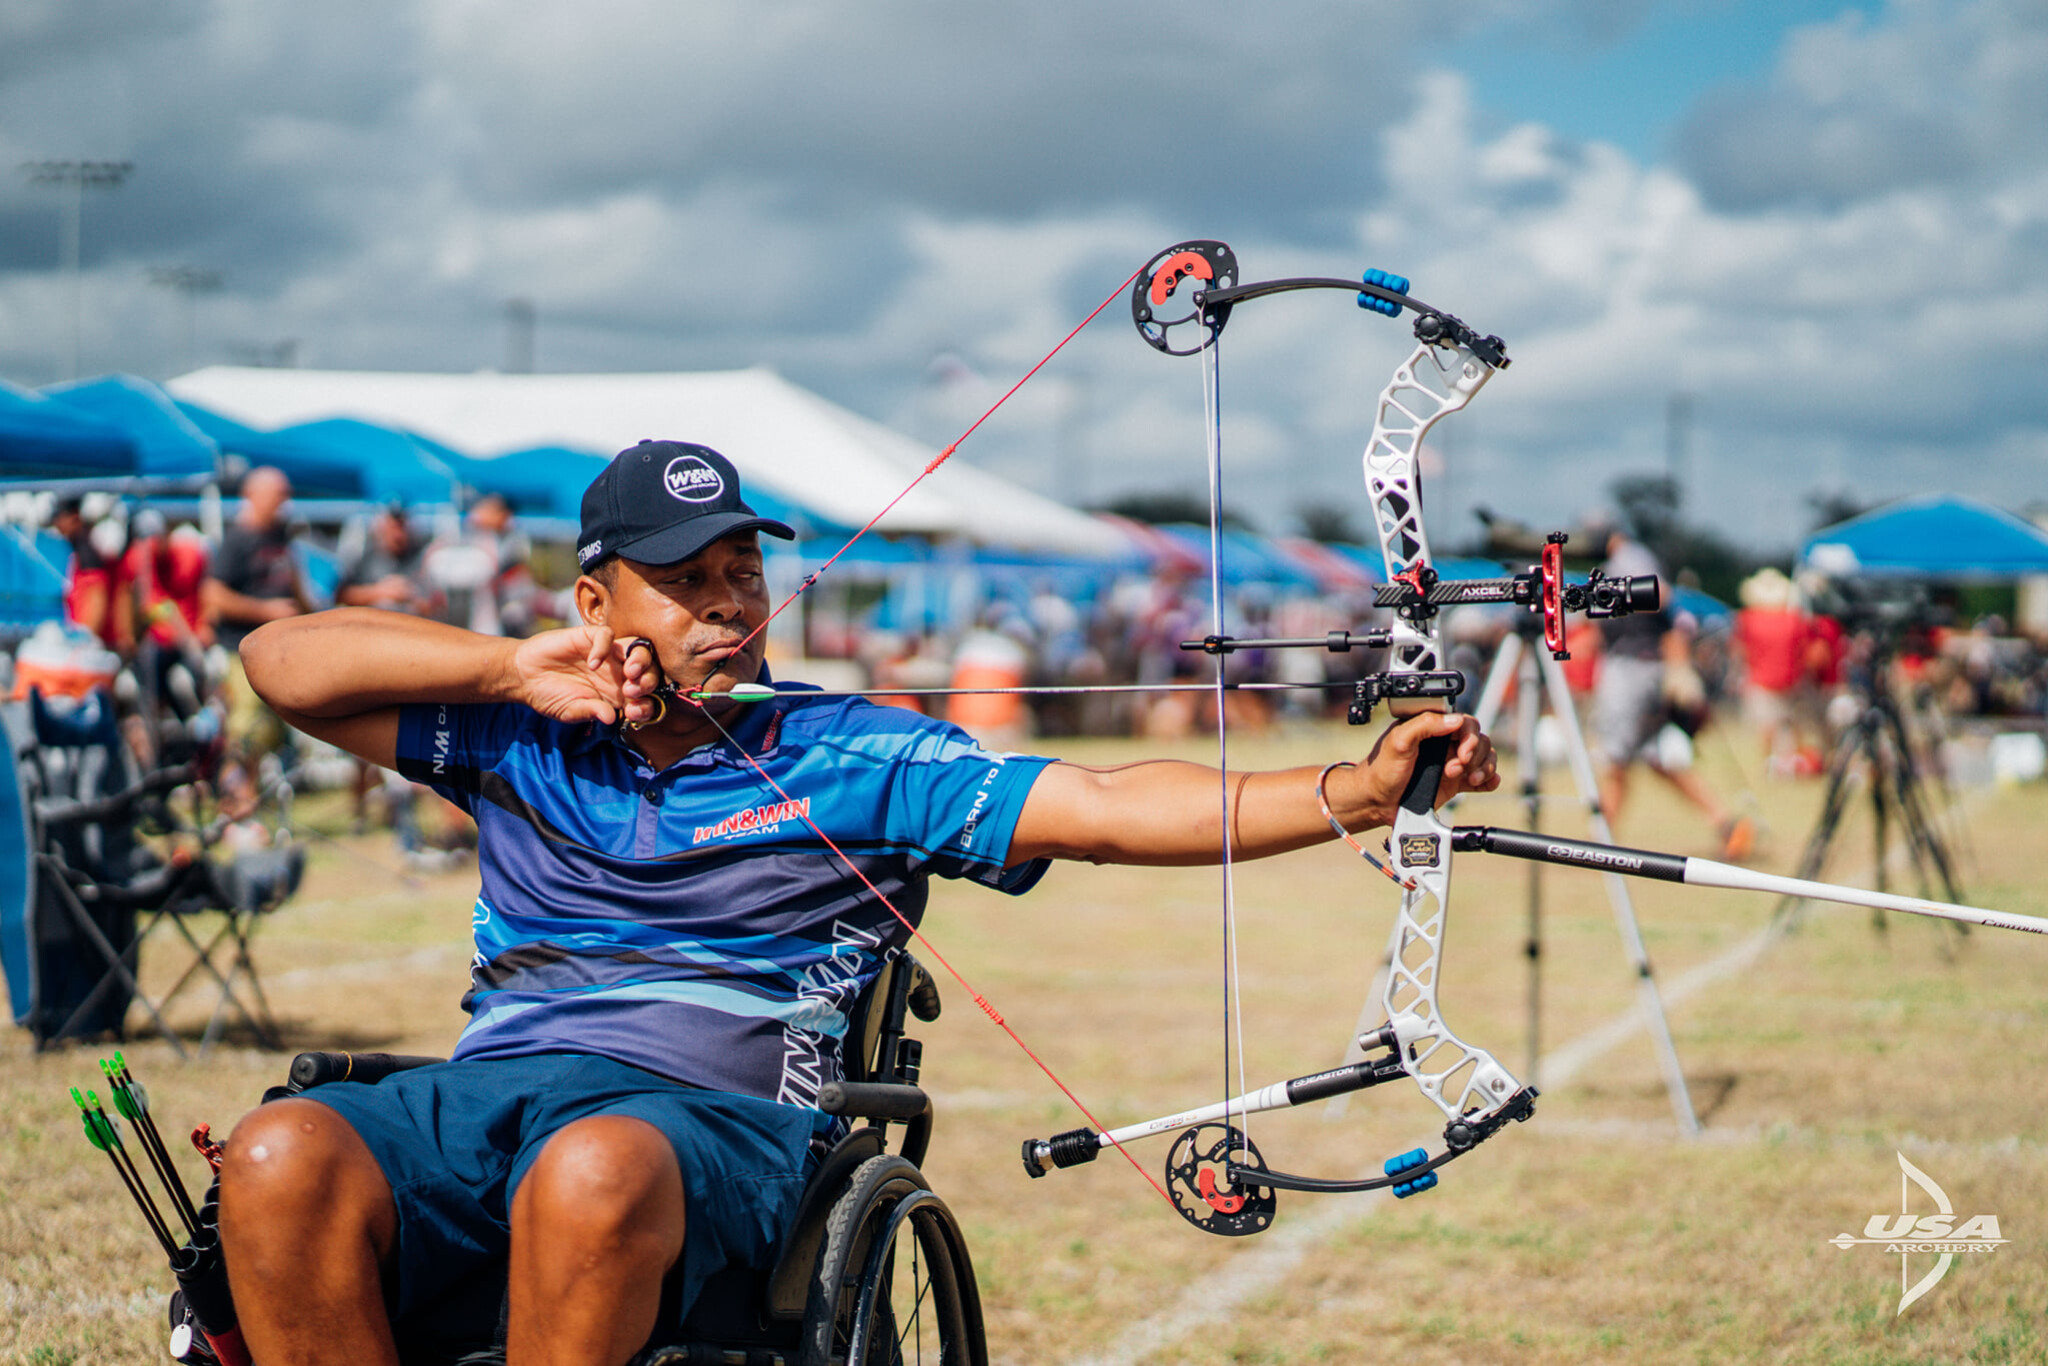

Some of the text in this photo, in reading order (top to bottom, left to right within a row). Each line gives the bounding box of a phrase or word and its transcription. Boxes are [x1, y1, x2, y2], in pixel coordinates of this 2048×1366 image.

[1462, 587, 1504, 597] AXCEL
[432, 730, 451, 775] WIN
[960, 768, 999, 848] BORN TO
[1572, 849, 1643, 869] EASTON
[1305, 1066, 1355, 1084] EASTON
